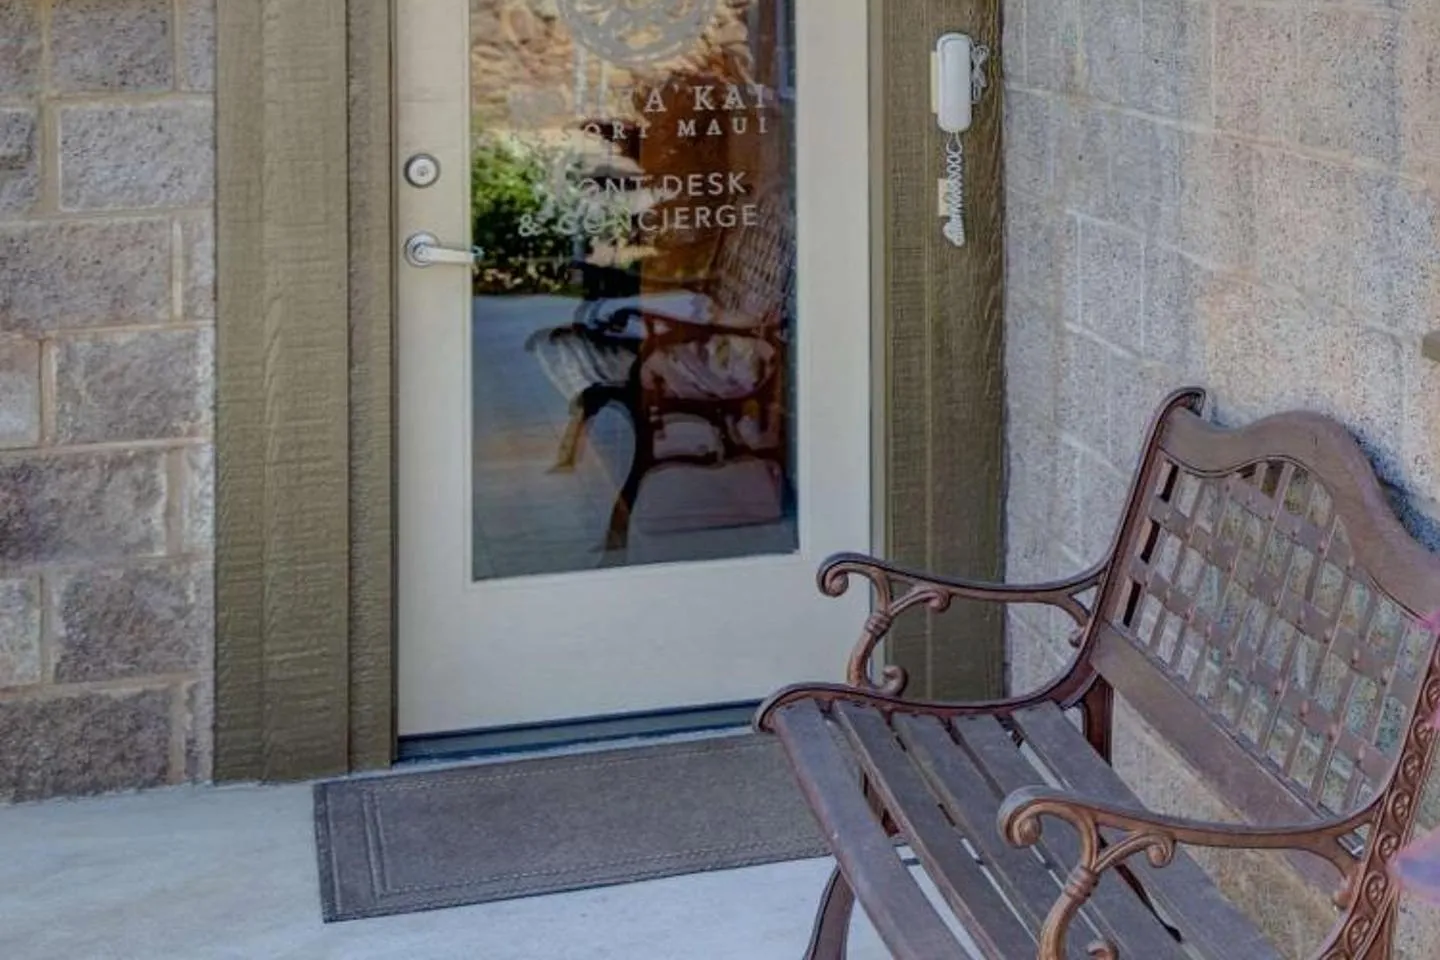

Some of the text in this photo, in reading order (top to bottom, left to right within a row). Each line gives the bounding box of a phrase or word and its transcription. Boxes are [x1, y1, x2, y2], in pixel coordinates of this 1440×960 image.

[693, 84, 768, 111] KAI
[677, 116, 769, 138] MAUI
[662, 171, 748, 197] DESK
[518, 213, 543, 238] &
